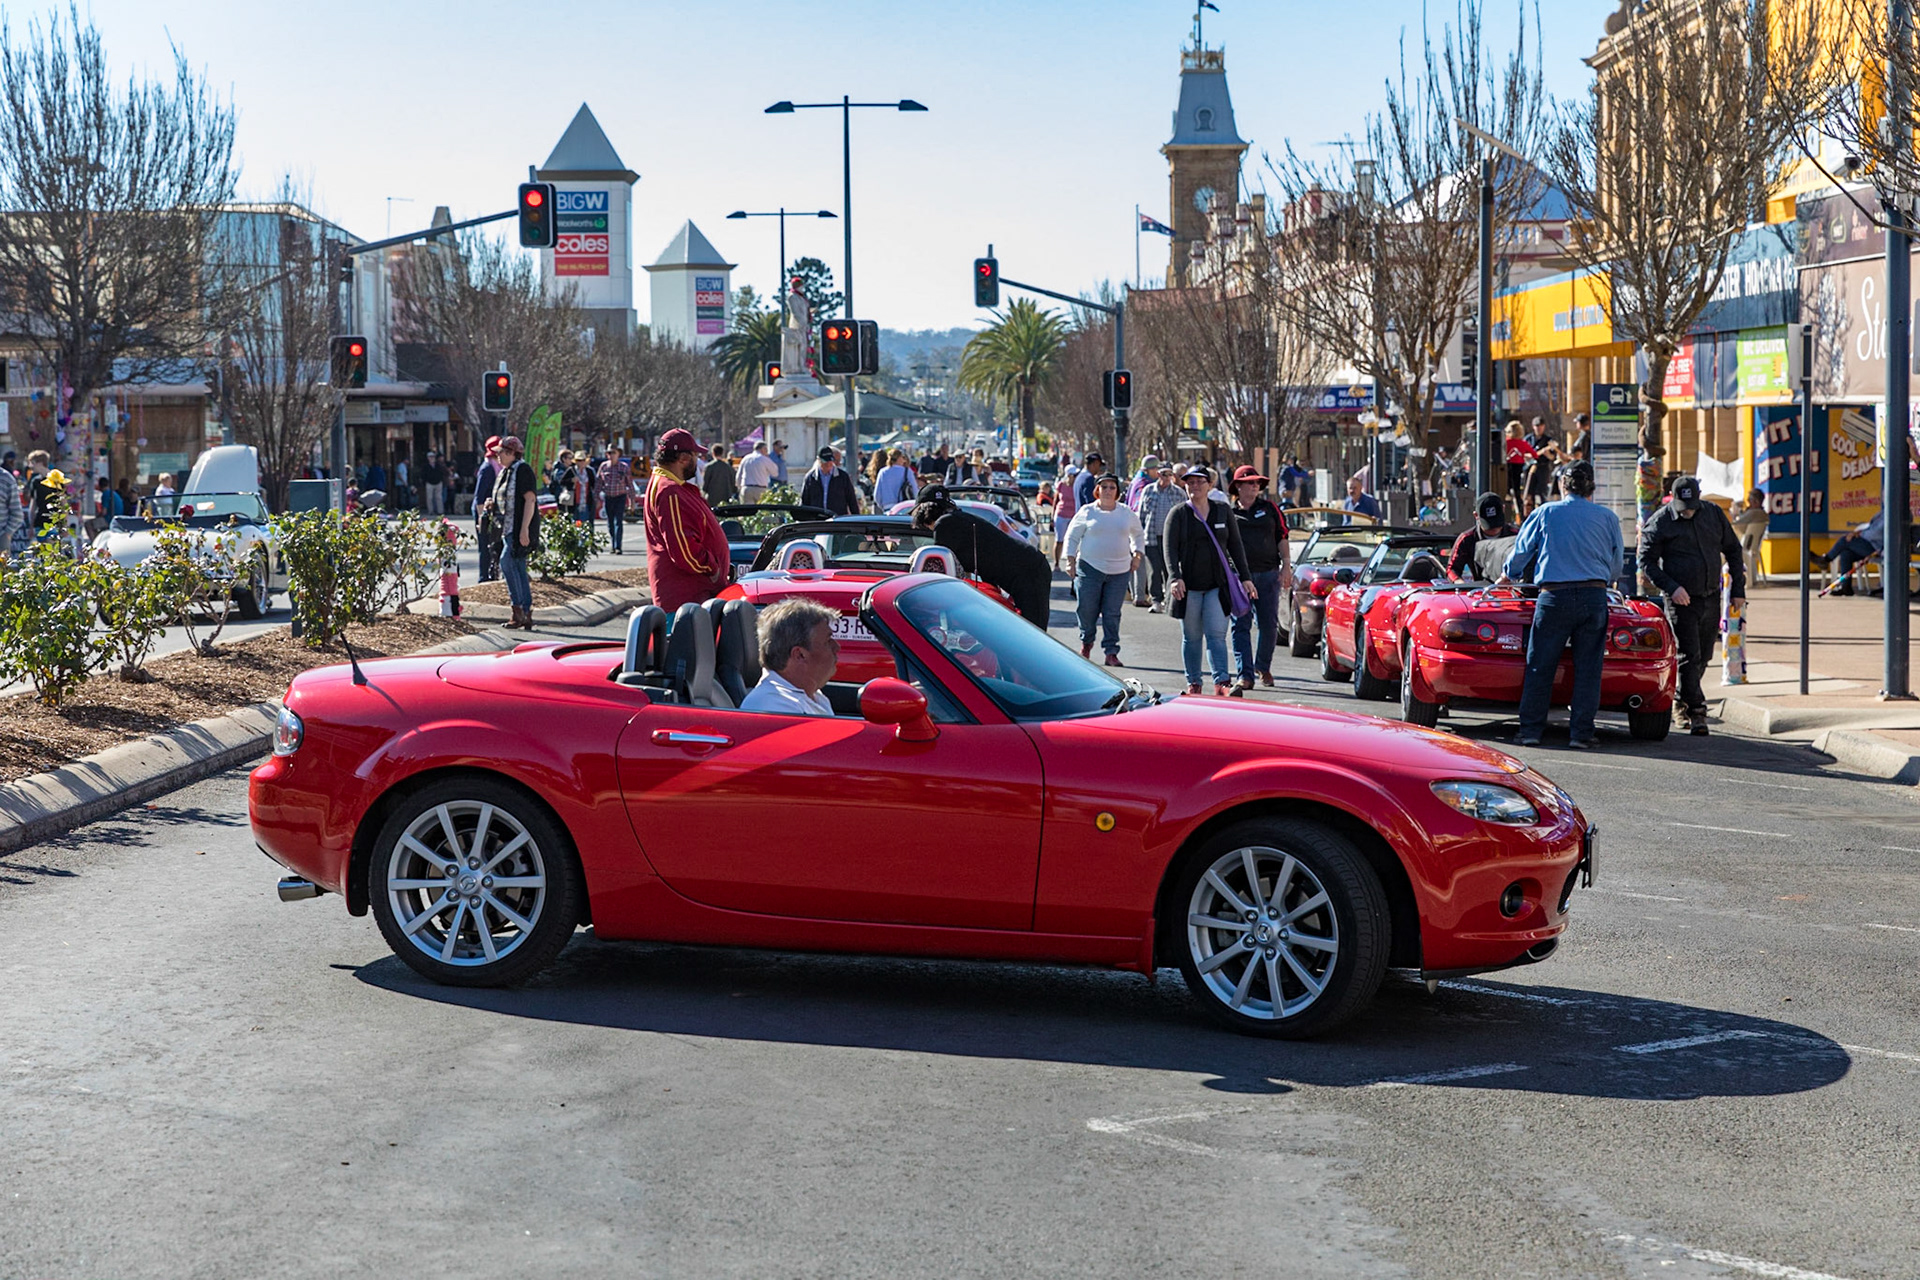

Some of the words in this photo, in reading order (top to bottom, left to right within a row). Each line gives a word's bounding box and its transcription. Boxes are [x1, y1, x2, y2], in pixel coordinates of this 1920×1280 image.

[556, 233, 608, 252] coles
[697, 291, 724, 304] coles
[1831, 431, 1859, 458] COOL
